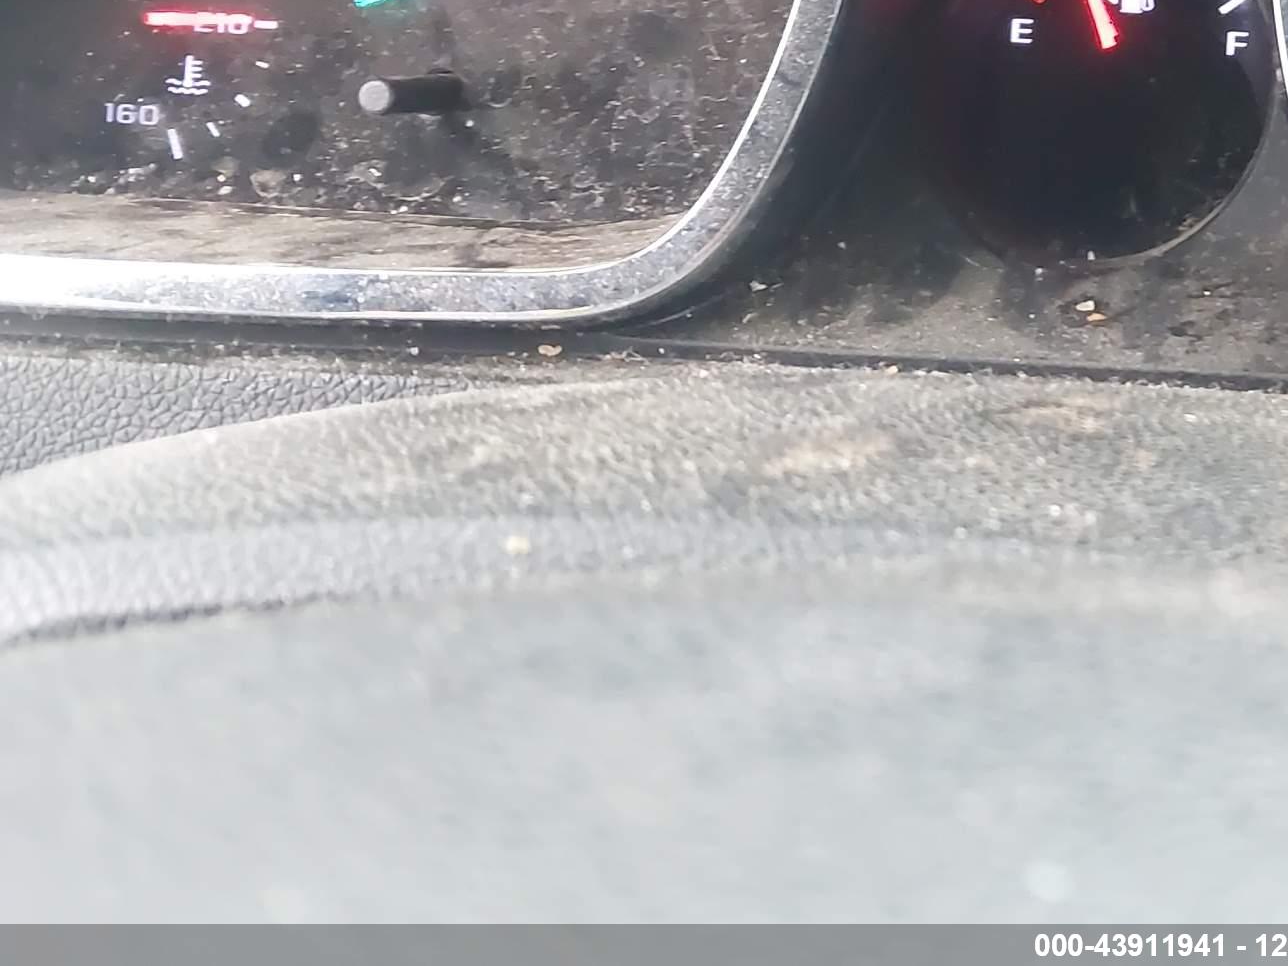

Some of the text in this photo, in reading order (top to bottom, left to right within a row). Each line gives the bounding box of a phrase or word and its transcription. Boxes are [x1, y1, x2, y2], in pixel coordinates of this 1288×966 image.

[1010, 18, 1034, 44] E
[1226, 31, 1249, 55] F
[104, 103, 159, 127] 160
